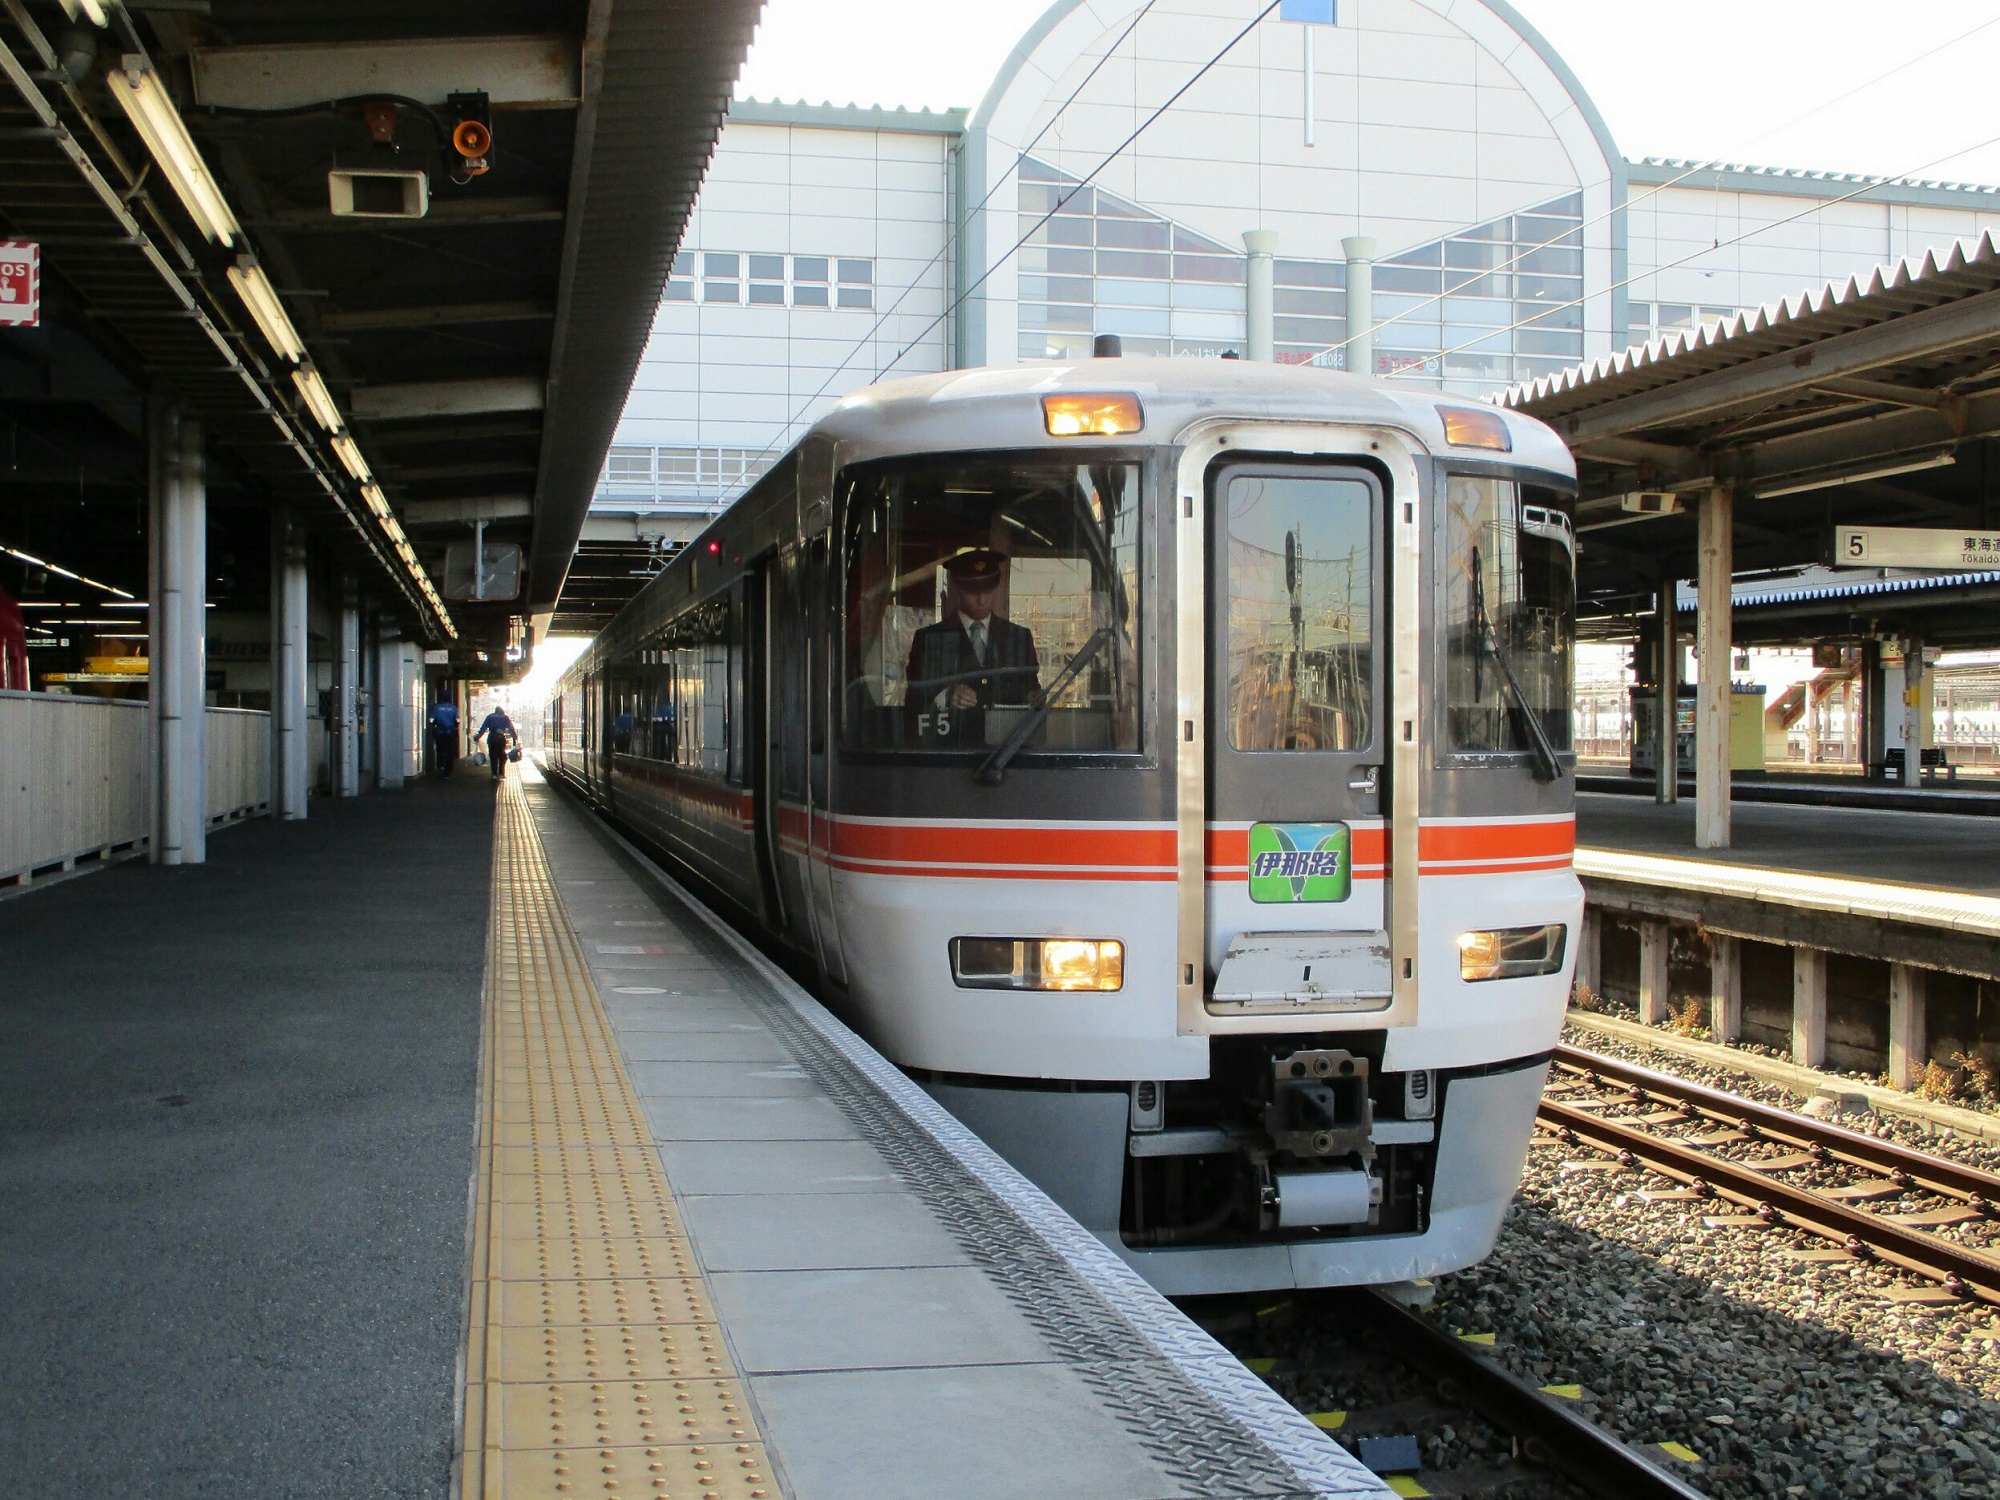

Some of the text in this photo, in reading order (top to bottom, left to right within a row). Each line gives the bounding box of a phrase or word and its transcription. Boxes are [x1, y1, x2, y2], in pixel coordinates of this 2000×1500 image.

[1850, 535, 1863, 557] 5
[1739, 657, 1746, 669] 7
[918, 712, 950, 736] F 5
[1253, 851, 1341, 878] 伊那路
